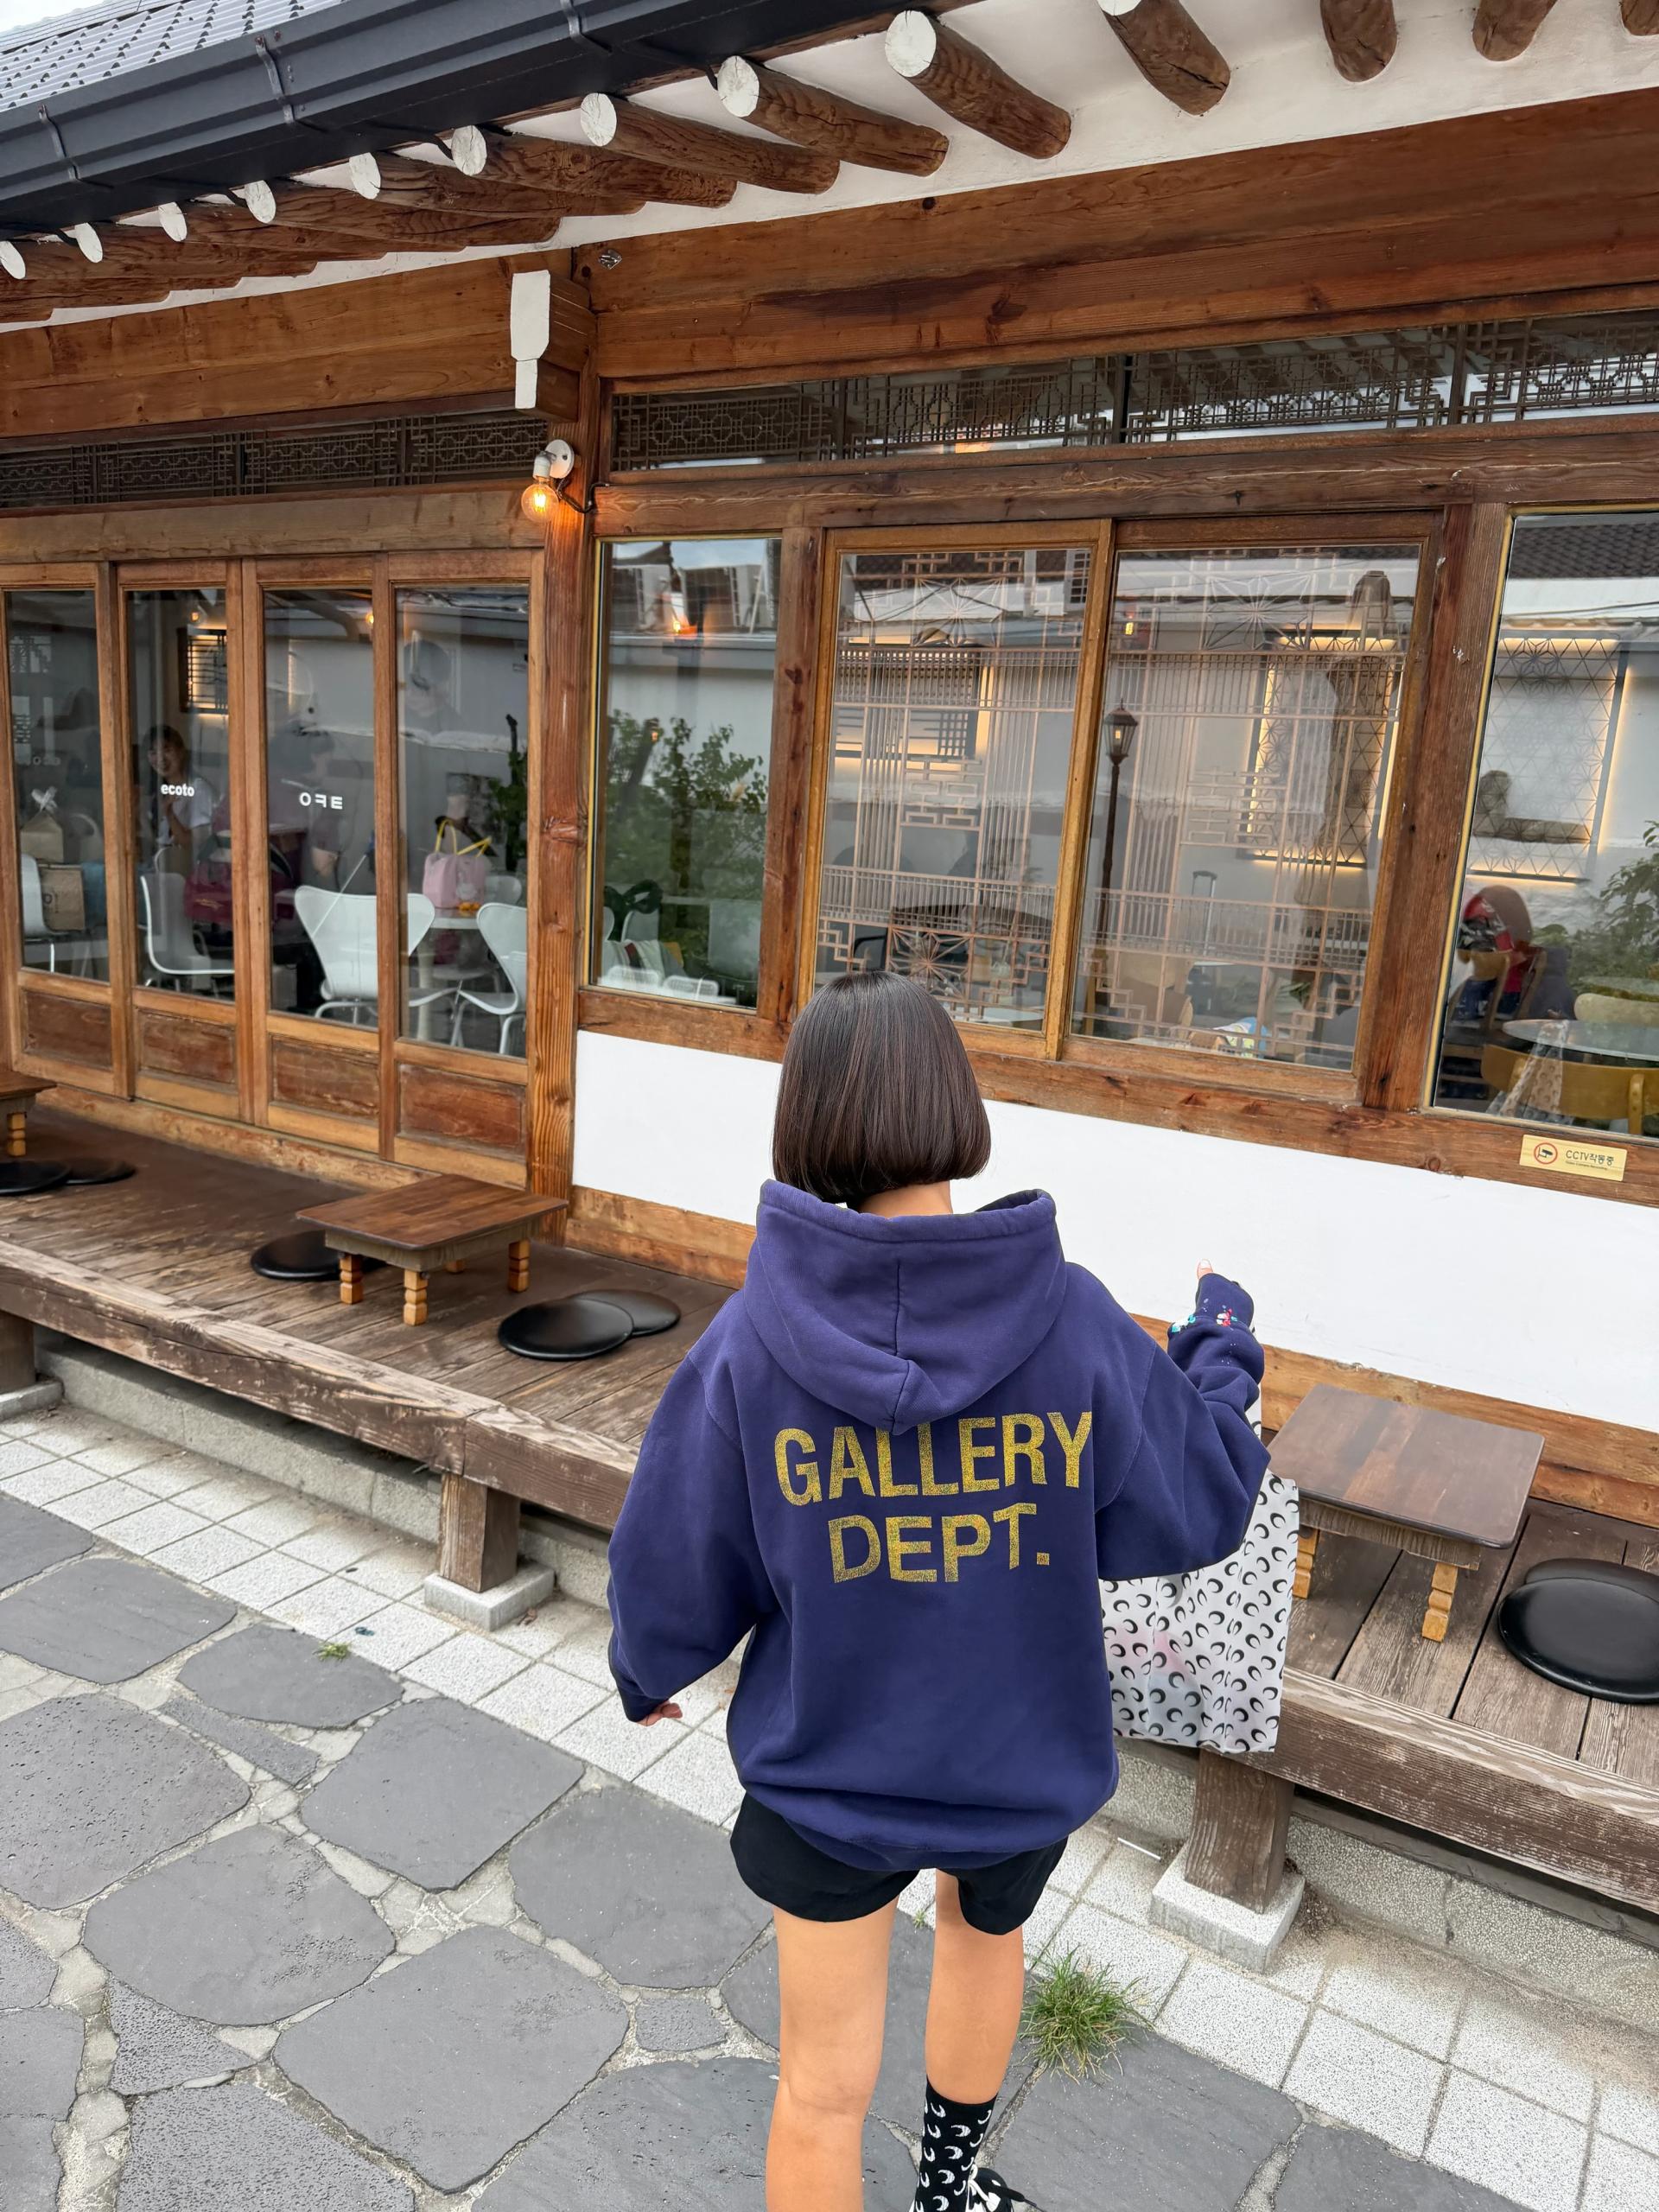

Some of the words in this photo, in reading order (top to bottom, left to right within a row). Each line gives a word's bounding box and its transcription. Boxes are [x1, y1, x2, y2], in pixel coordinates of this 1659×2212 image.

[161, 784, 194, 797] ecoto
[1566, 1150, 1614, 1166] CCTV작동중
[774, 1411, 1092, 1506] GALLERY
[828, 1502, 1050, 1583] DEPT.
